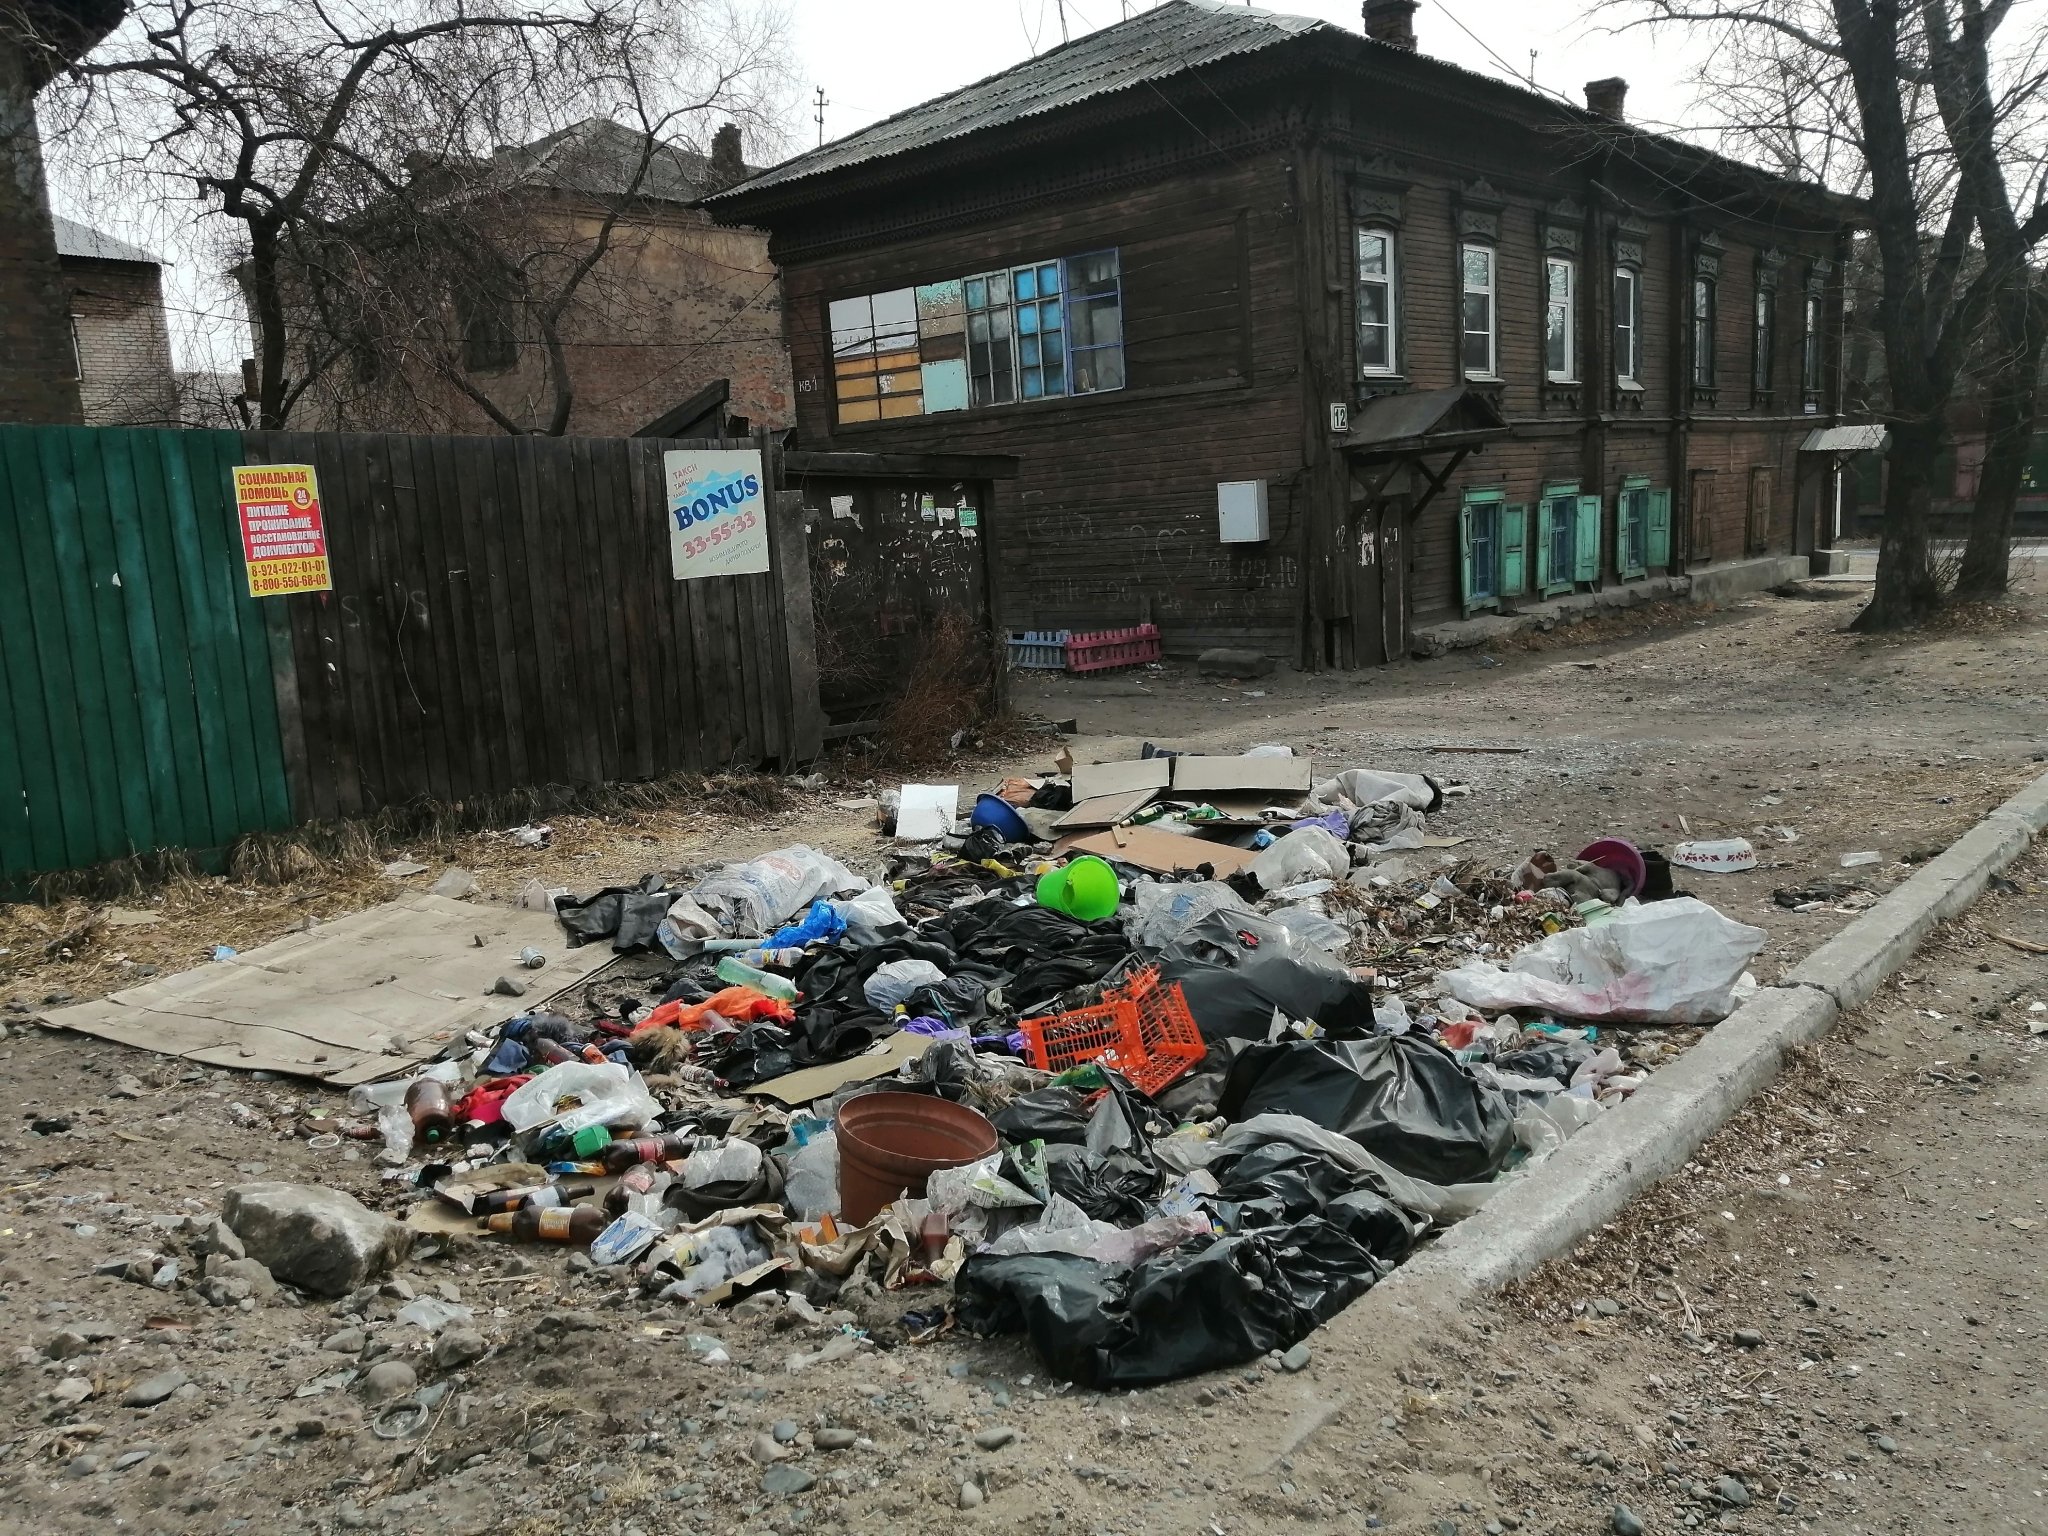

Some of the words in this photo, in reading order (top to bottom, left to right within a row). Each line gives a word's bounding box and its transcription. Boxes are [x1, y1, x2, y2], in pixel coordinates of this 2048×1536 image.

[1335, 408, 1346, 427] 12
[238, 471, 308, 487] СОЦИАЛЬНАЯ
[673, 463, 698, 480] ТАКСИ
[240, 487, 289, 501] ПОМОЩЬ
[673, 474, 759, 531] BONUS
[246, 504, 290, 518] ПИТАНИЕ
[248, 517, 313, 532] ПРОЖИВАНИЕ
[250, 530, 321, 544] ВОССТАНОВЛЕНИЕ
[683, 511, 757, 560] 33-55-33
[253, 542, 316, 559] ДОКУМЕНТОВ
[251, 560, 326, 577] 8-924-022-01-01
